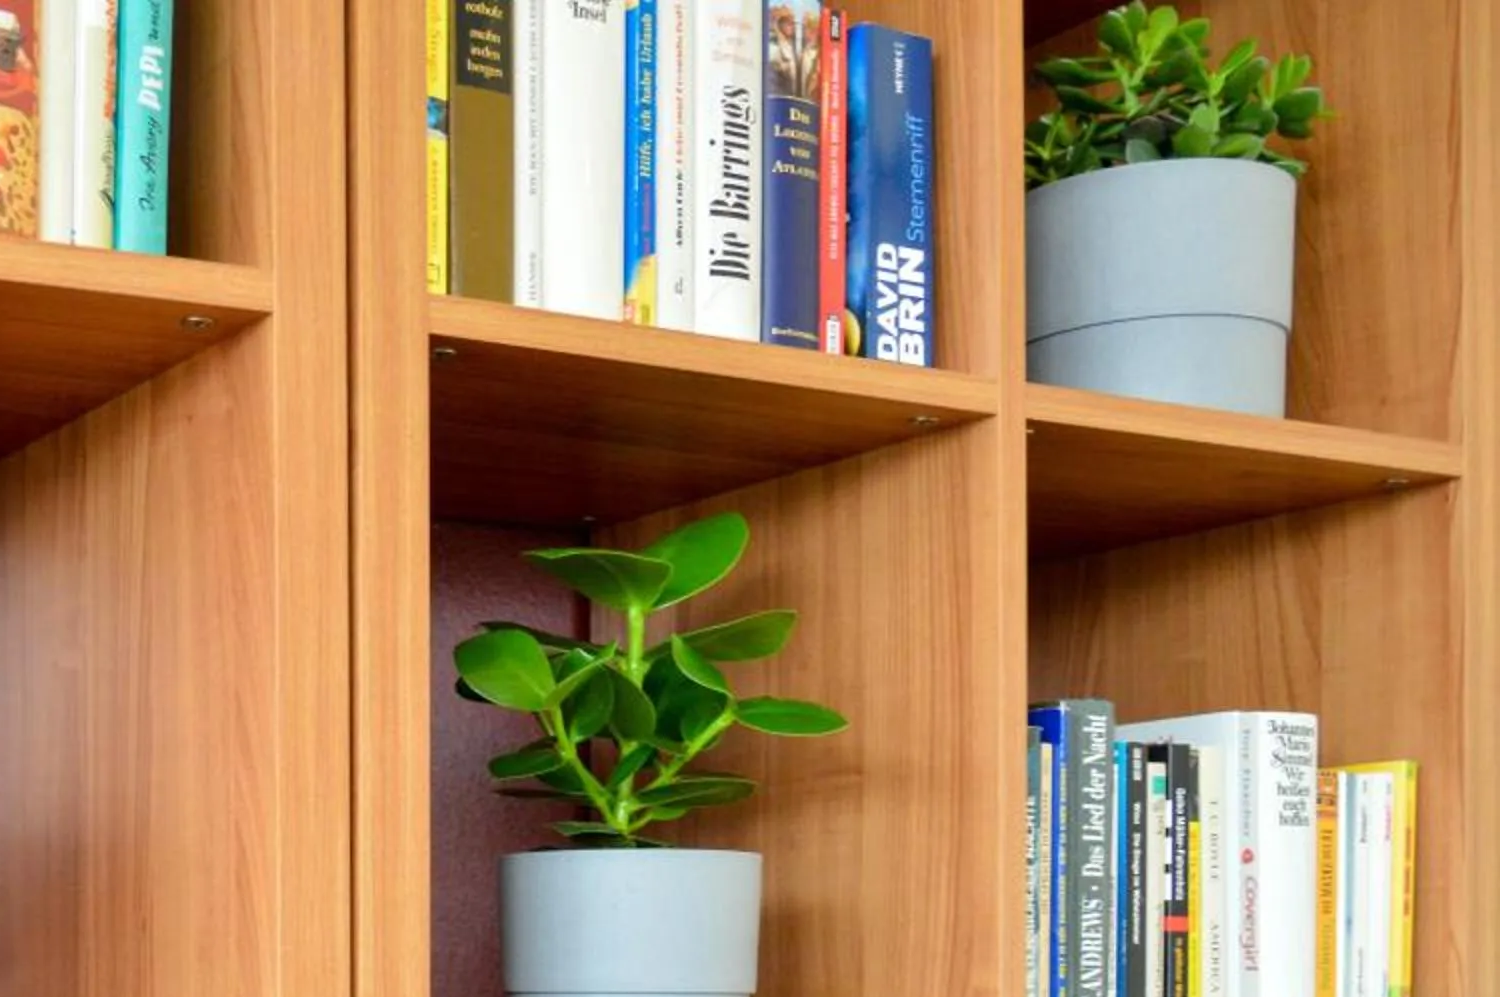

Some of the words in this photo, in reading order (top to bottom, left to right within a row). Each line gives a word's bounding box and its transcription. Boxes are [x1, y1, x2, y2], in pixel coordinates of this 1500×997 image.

[638, 13, 652, 64] Urlaub
[137, 43, 165, 111] PEPI
[638, 67, 652, 104] habe
[893, 57, 906, 93] HEYNE
[638, 108, 652, 132] ich
[139, 116, 164, 176] Avery
[638, 138, 653, 178] Hilfe,
[708, 85, 756, 222] Barrings
[905, 112, 925, 243] Sternenriff
[708, 231, 750, 281] Die
[876, 242, 898, 362] DAVID
[898, 246, 925, 367] BRIN
[1083, 714, 1108, 766] Nacht
[1268, 719, 1314, 737] Johannes
[1276, 735, 1311, 752] Mario
[1270, 748, 1313, 768] Simmel
[1283, 766, 1306, 781] Wir
[1083, 768, 1107, 801] der
[1282, 798, 1307, 811] euch
[1082, 801, 1106, 842] Lied
[1081, 844, 1105, 878] Das
[1209, 833, 1220, 880] BOYLE
[1241, 875, 1259, 971] Covergirl
[1209, 920, 1220, 993] AMERICA
